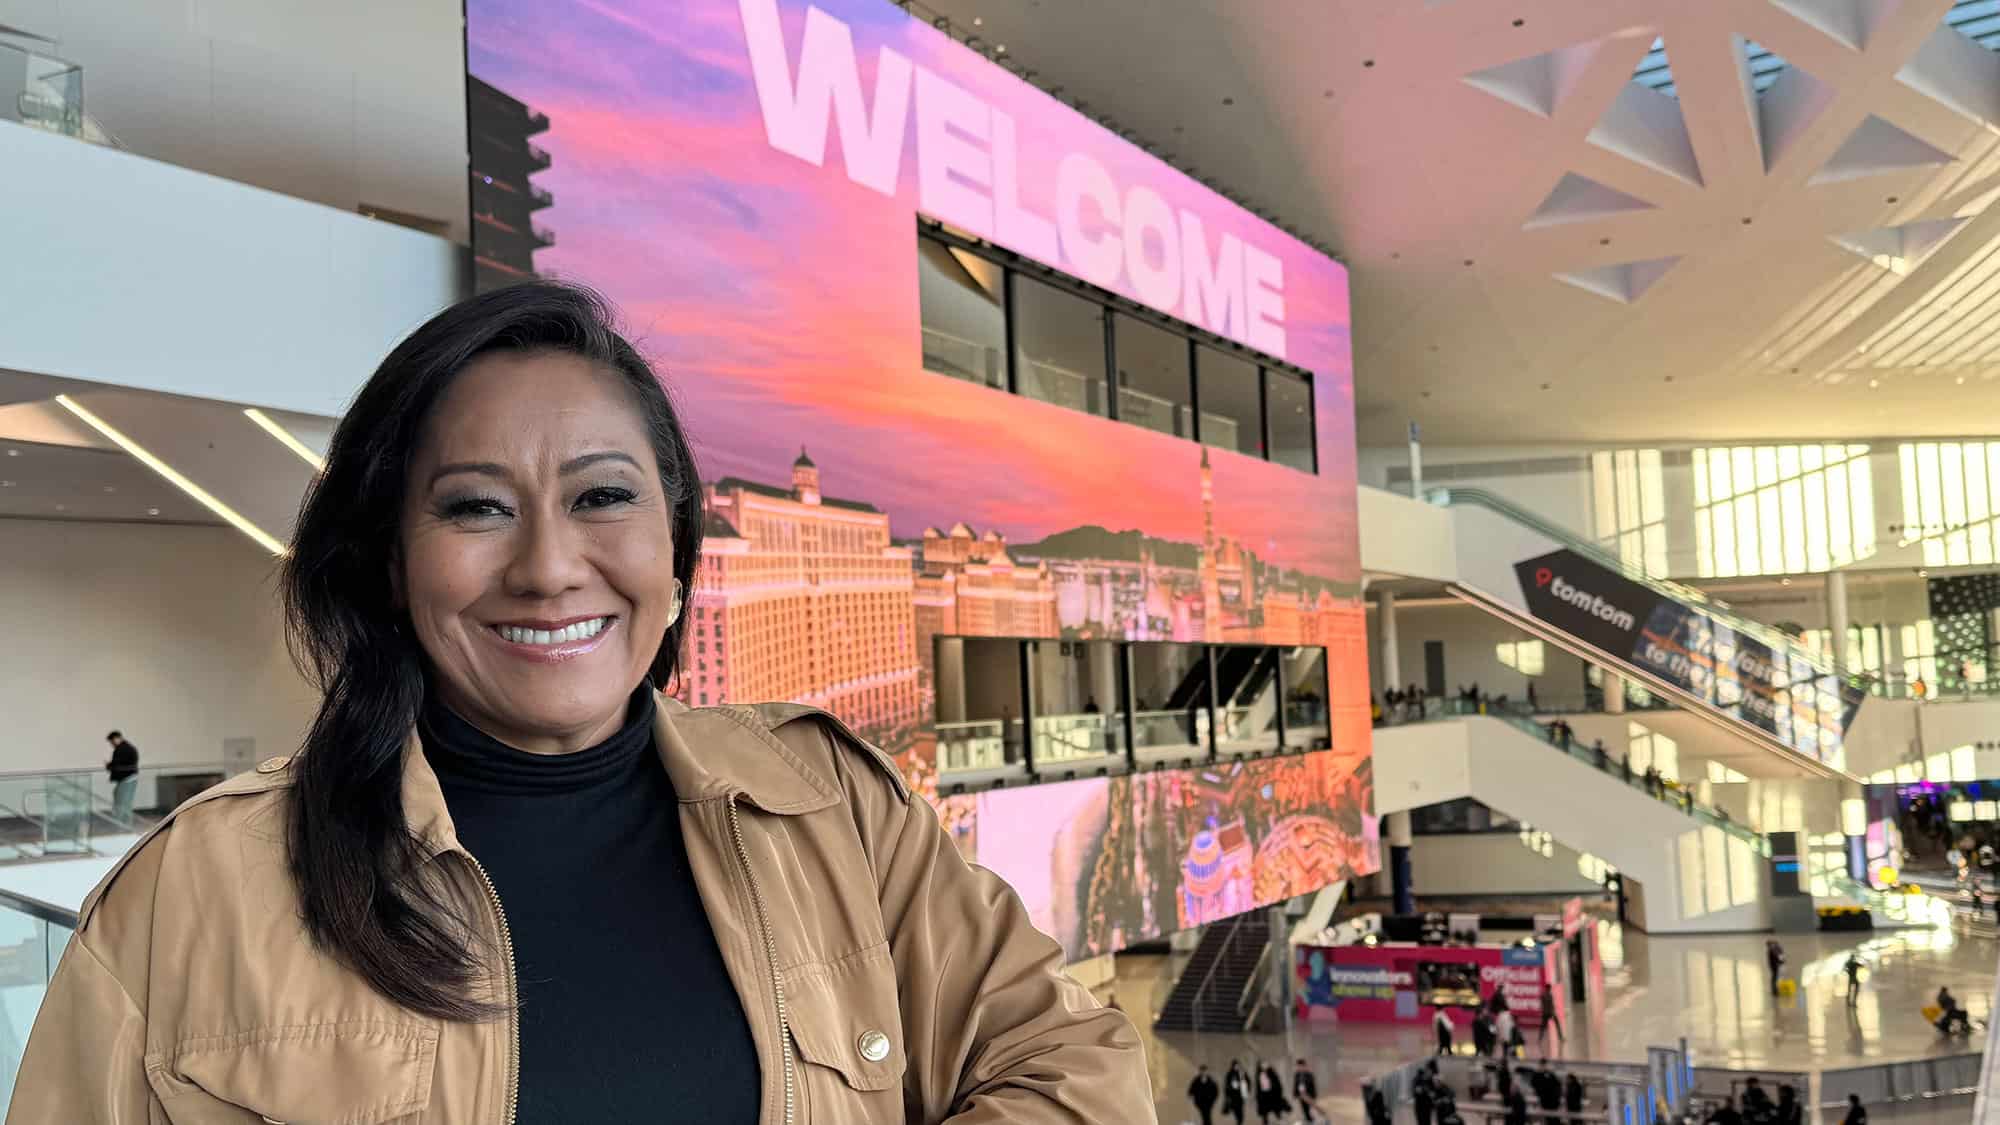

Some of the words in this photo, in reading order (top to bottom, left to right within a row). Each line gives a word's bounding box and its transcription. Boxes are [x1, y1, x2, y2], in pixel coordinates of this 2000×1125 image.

[739, 0, 1286, 358] WELCOME
[1551, 576, 1635, 631] tomtom
[1329, 968, 1412, 985] Innovators
[1481, 966, 1538, 983] Official
